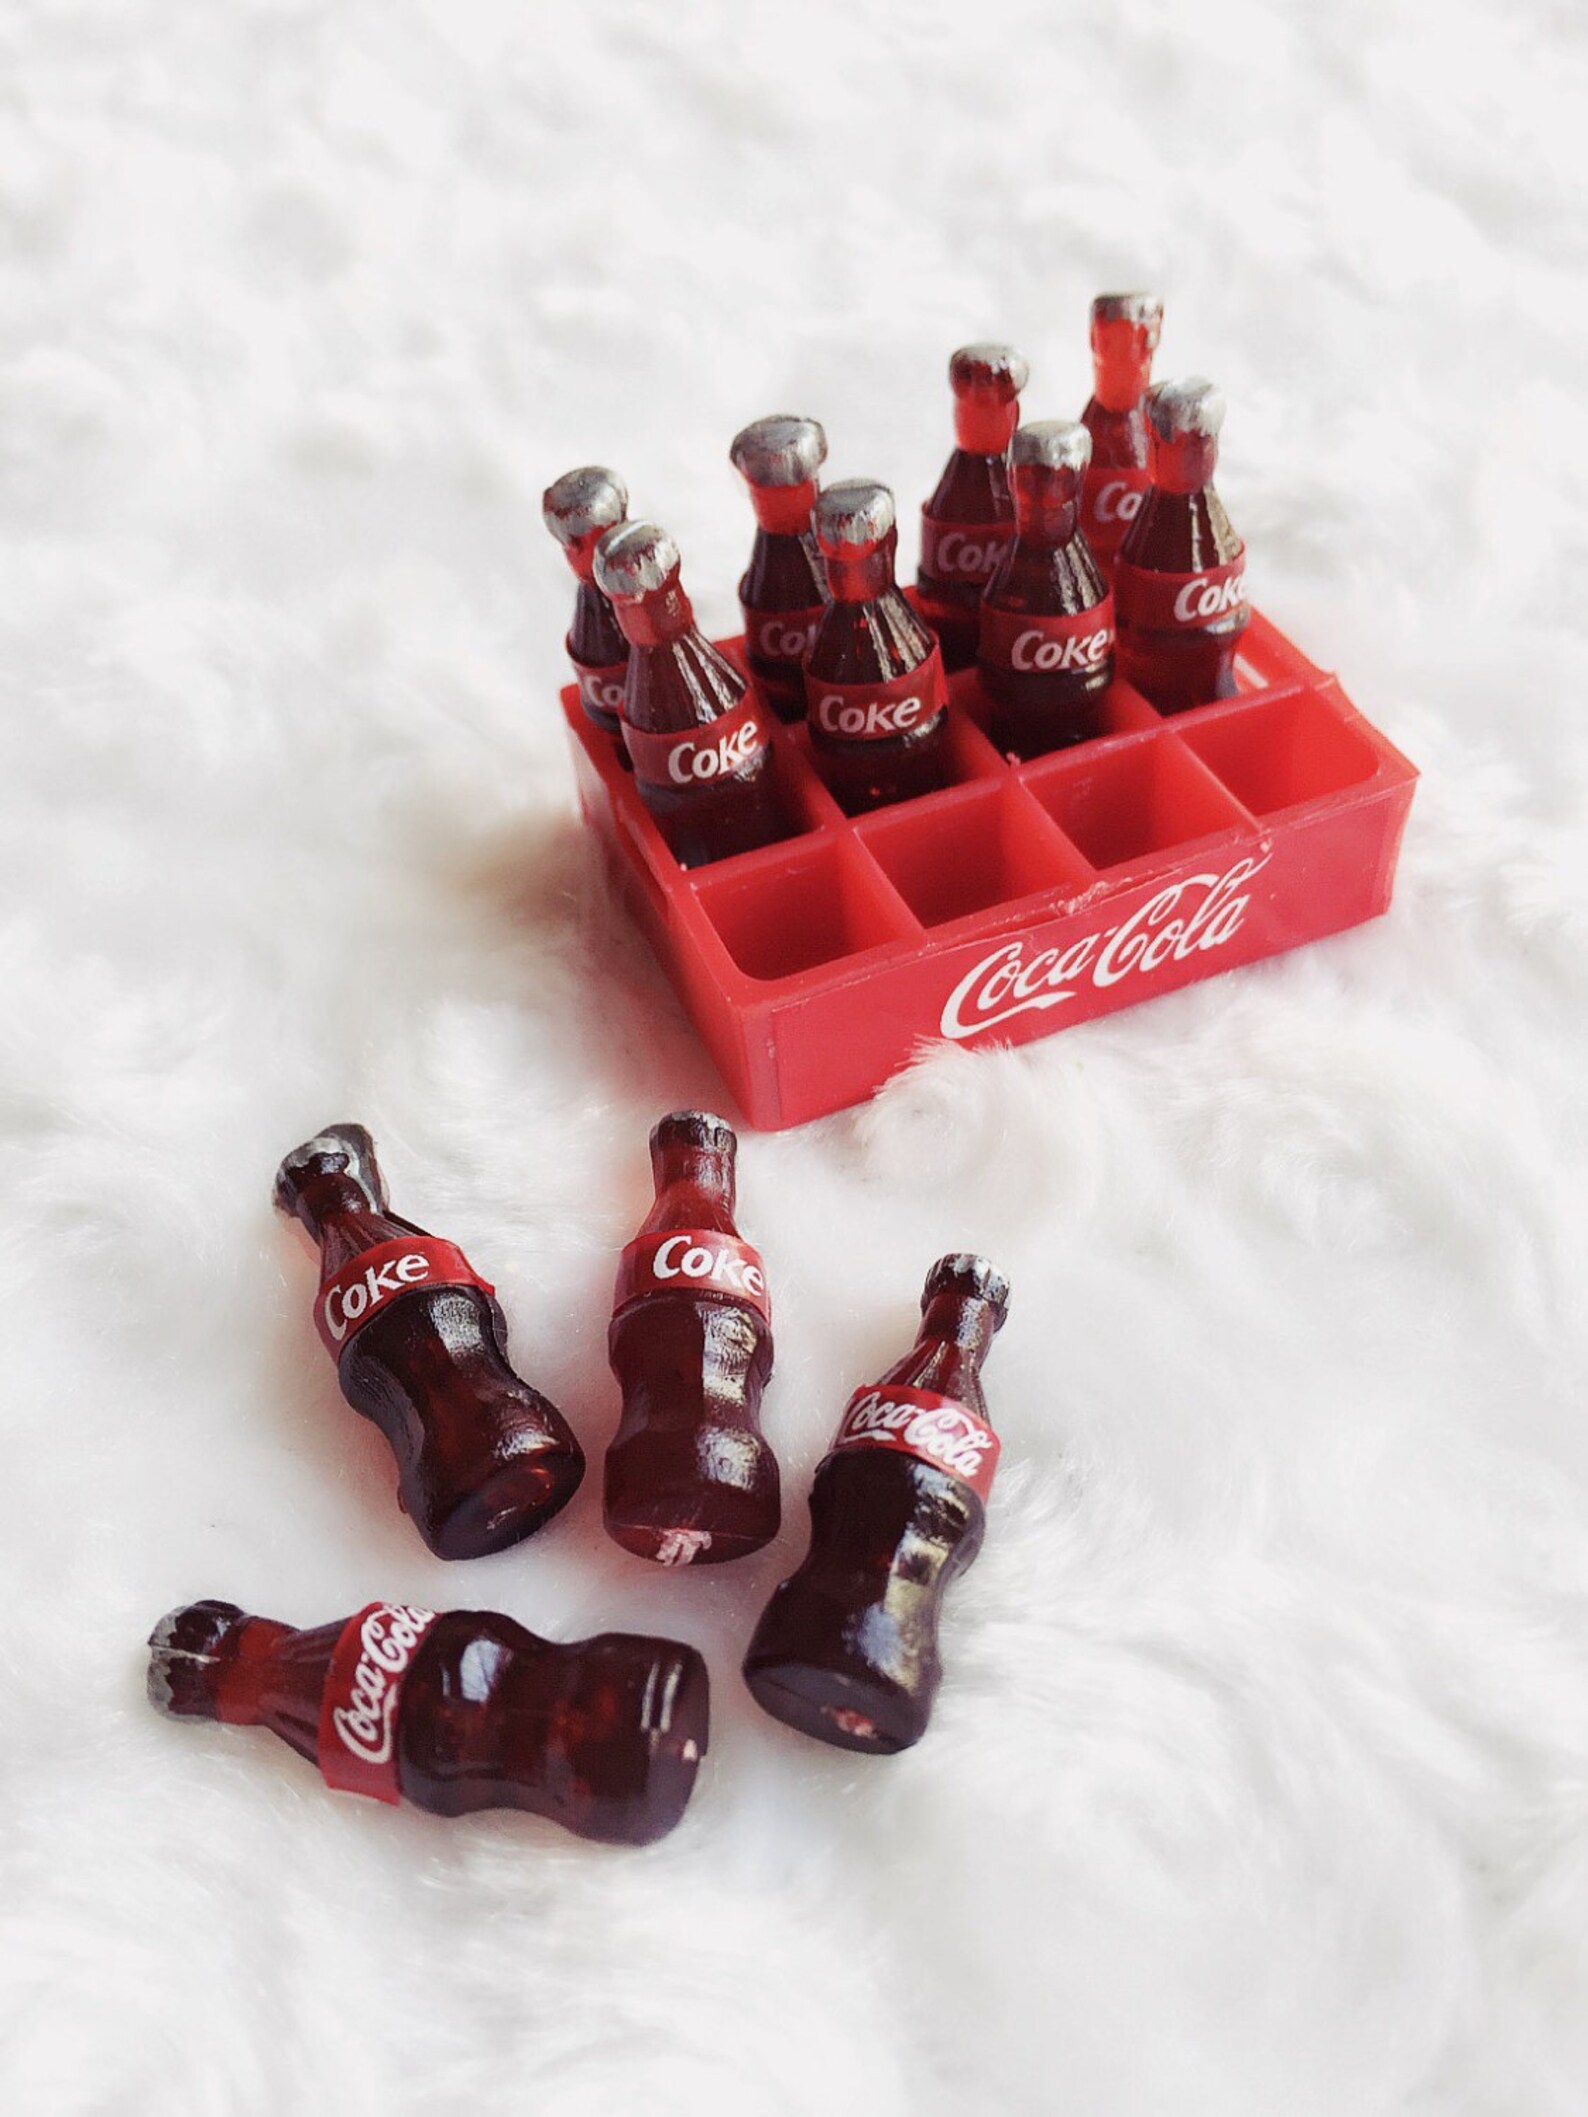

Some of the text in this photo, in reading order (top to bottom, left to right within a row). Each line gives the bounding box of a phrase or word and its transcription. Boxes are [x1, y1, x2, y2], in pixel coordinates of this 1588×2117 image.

[1094, 481, 1142, 523] Co
[938, 532, 1009, 573] Cok
[760, 621, 817, 656] Co
[1011, 629, 1108, 671] Coke
[584, 675, 625, 707] Co
[819, 695, 921, 733] Coke
[668, 721, 757, 783] Coke
[940, 852, 1272, 1039] Coca-Cola
[653, 1235, 764, 1296] Coke
[324, 1254, 430, 1341] Coke
